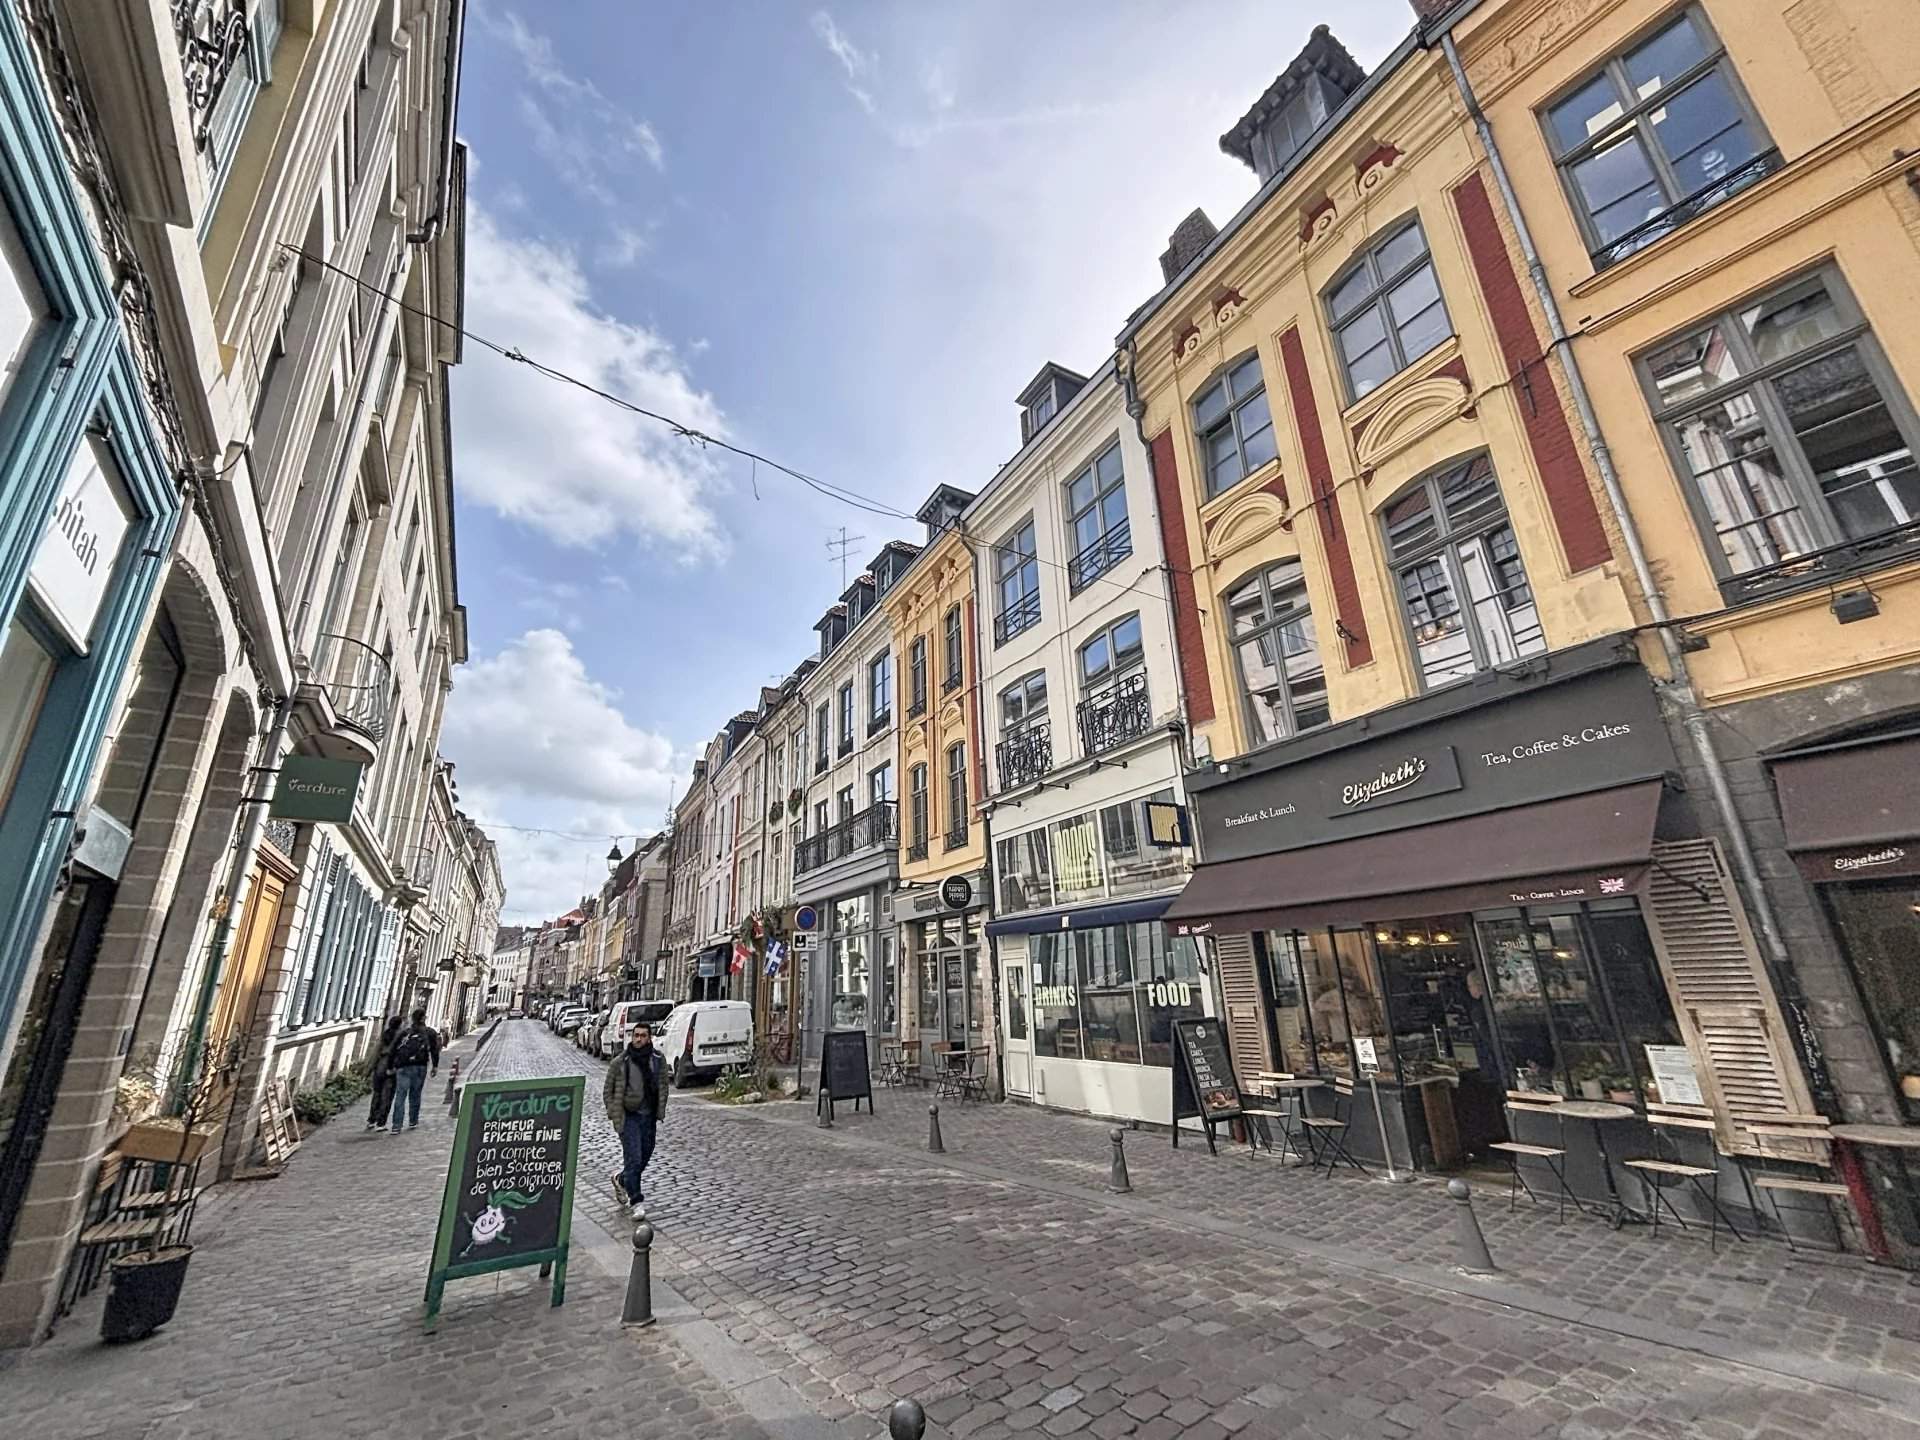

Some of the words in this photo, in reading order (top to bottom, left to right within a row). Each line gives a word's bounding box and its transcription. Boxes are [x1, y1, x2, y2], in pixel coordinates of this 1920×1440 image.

[1482, 753, 1511, 766] Tea,
[1512, 740, 1559, 759] Coffee
[1562, 734, 1580, 747] &
[1581, 724, 1631, 742] Cakes
[1343, 757, 1426, 805] Elizabeth's
[1225, 813, 1258, 828] Breakfast
[1259, 809, 1269, 820] &
[1269, 803, 1296, 817] Lunch
[1054, 821, 1100, 893] DROPS
[1834, 847, 1905, 871] Elizabeth's
[1034, 985, 1077, 1007] DRINKS
[1147, 982, 1191, 1007] FOOD
[500, 1146, 546, 1161] compte
[476, 1164, 503, 1178] bien
[470, 1182, 487, 1195] de
[492, 1176, 515, 1190] vos
